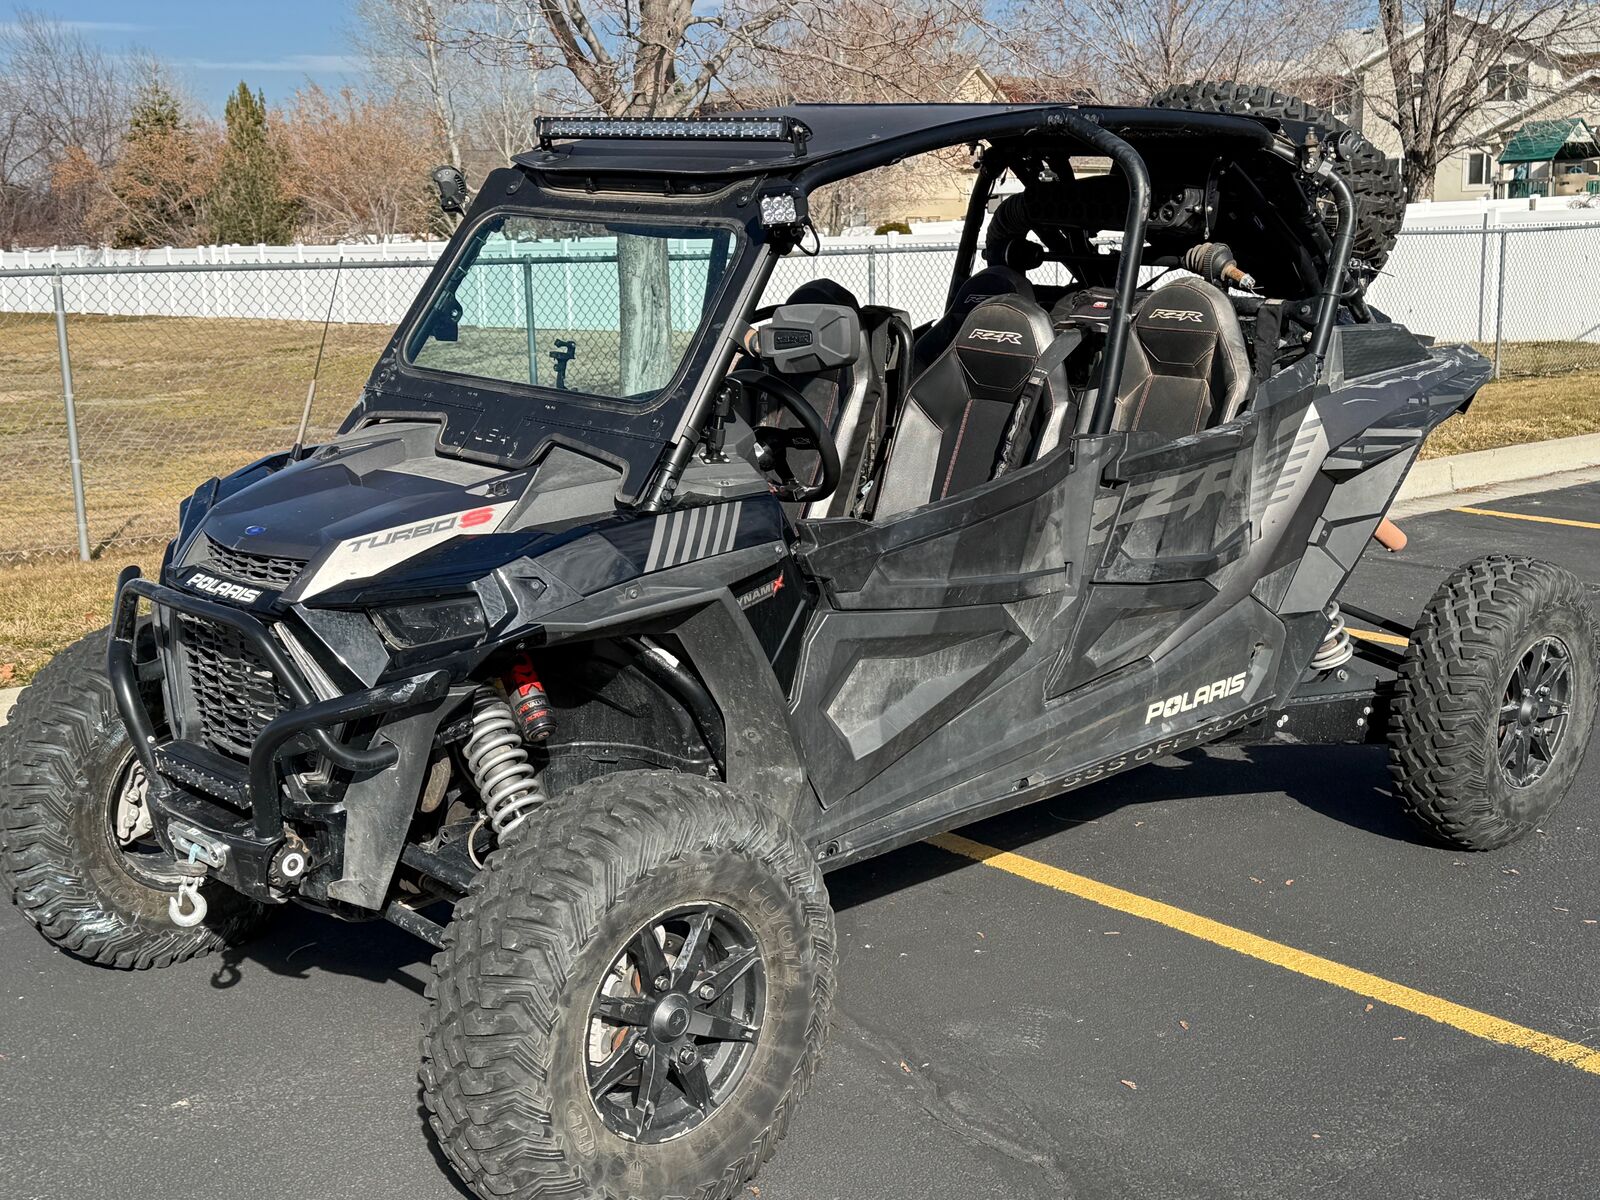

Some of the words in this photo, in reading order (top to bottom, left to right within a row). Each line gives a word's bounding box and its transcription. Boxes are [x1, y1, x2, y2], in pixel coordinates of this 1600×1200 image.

[1148, 308, 1204, 323] RZR
[968, 328, 1023, 345] RZR
[184, 572, 264, 604] POLARIS
[736, 569, 785, 606] YNAMIX
[1144, 671, 1247, 725] POLARIS
[1133, 734, 1191, 762] OFF
[1194, 703, 1268, 741] ROAD
